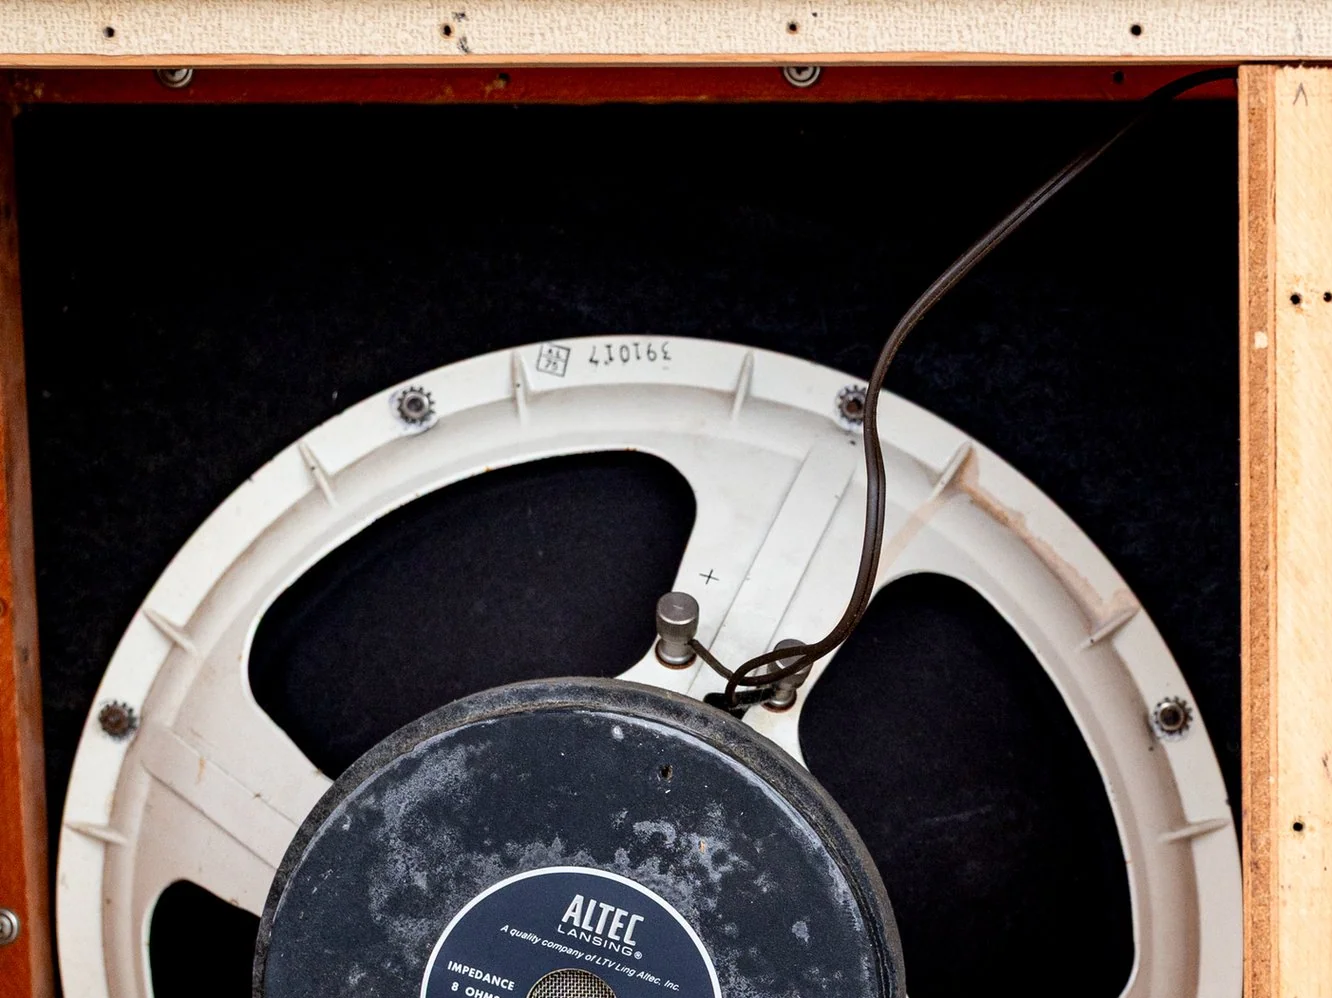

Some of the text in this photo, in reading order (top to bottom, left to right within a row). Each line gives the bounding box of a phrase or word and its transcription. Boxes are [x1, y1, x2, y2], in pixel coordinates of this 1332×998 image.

[562, 894, 644, 946] ALTEC
[447, 961, 515, 991] IMPEDANCE
[500, 925, 509, 933] A
[509, 927, 540, 945] quality
[541, 938, 584, 960] company
[585, 952, 595, 961] of
[595, 957, 614, 969] LTV
[615, 964, 636, 976] Ling
[665, 980, 680, 991] Inc.
[451, 982, 458, 992] 8
